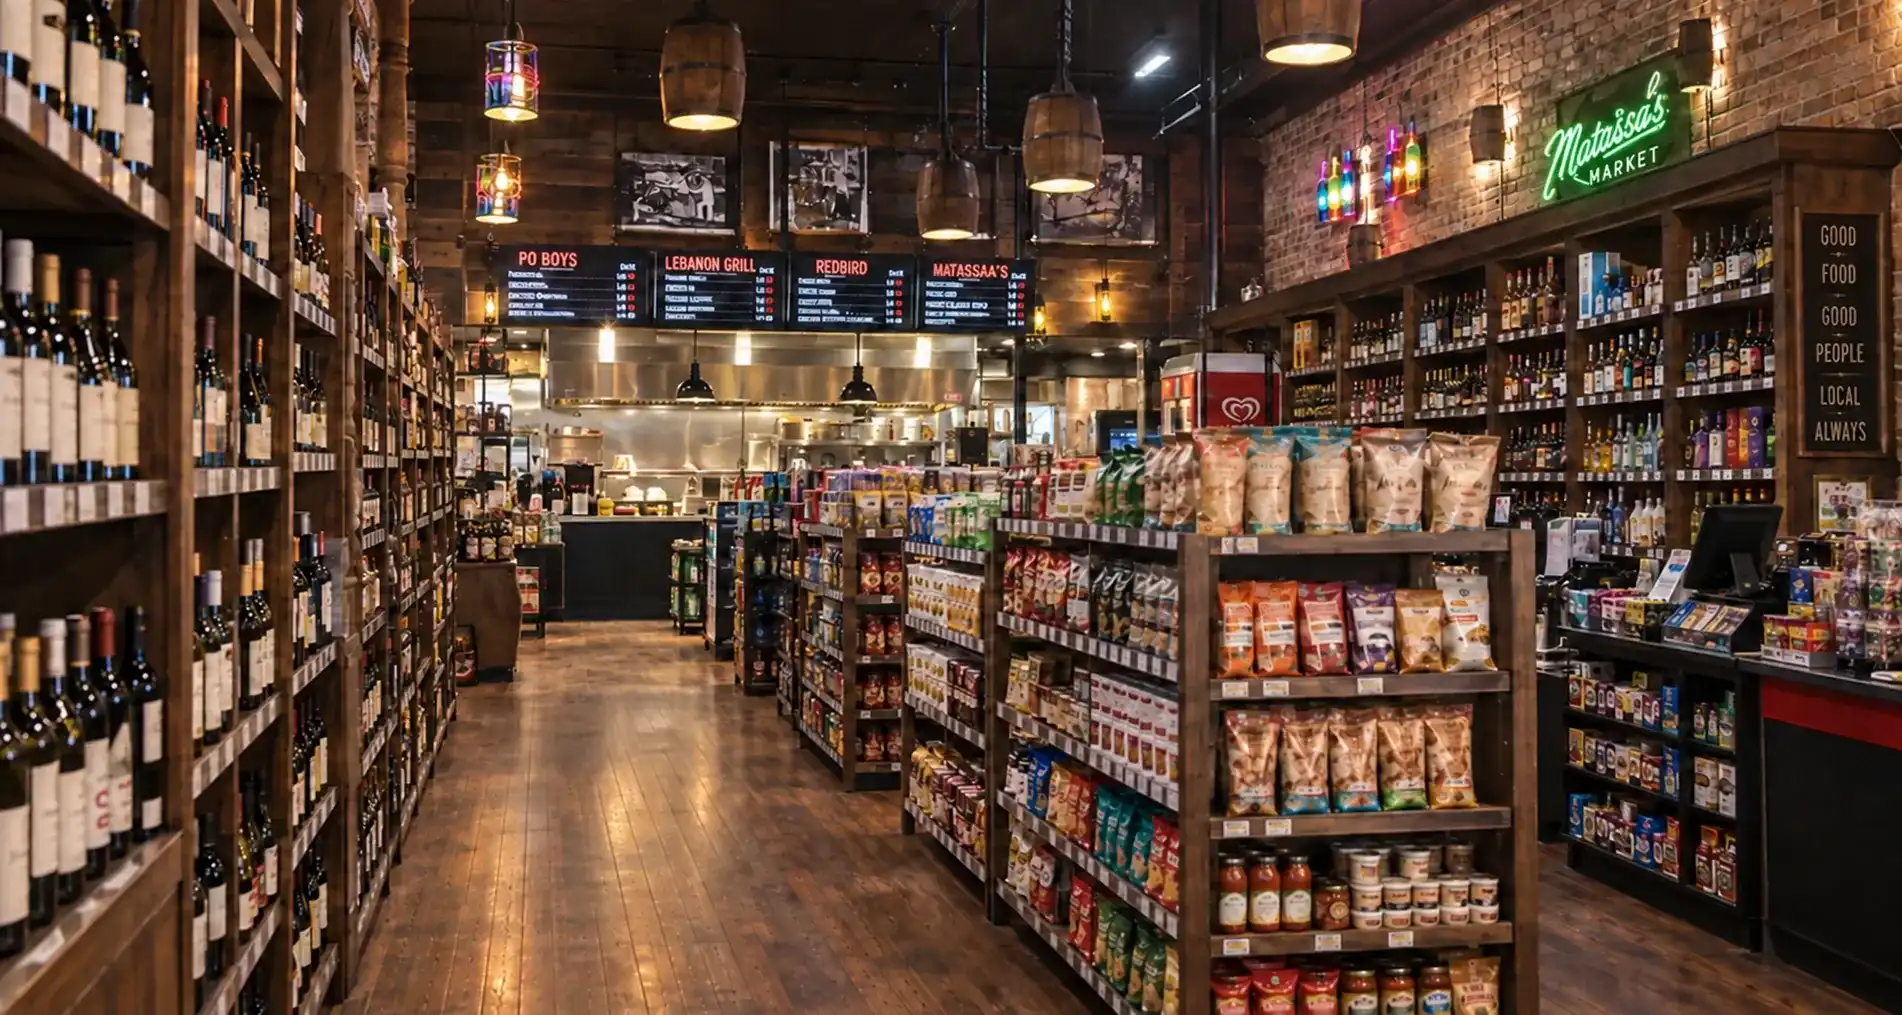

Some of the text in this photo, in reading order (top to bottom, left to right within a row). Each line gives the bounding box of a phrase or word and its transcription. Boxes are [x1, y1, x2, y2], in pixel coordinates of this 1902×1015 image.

[1588, 145, 1659, 186] MARKET
[1820, 225, 1857, 247] GOOD
[518, 251, 578, 268] PO BOYS
[665, 255, 756, 273] LEBANON GRILL
[815, 259, 868, 276] REDBIRD
[932, 263, 1009, 279] MATASSAA'S
[1821, 263, 1857, 285] FOOD
[1821, 305, 1857, 327] GOOD
[1815, 342, 1864, 364] PEOPLE
[1819, 385, 1861, 406] LOCAL
[1814, 421, 1867, 442] ALWAYS
